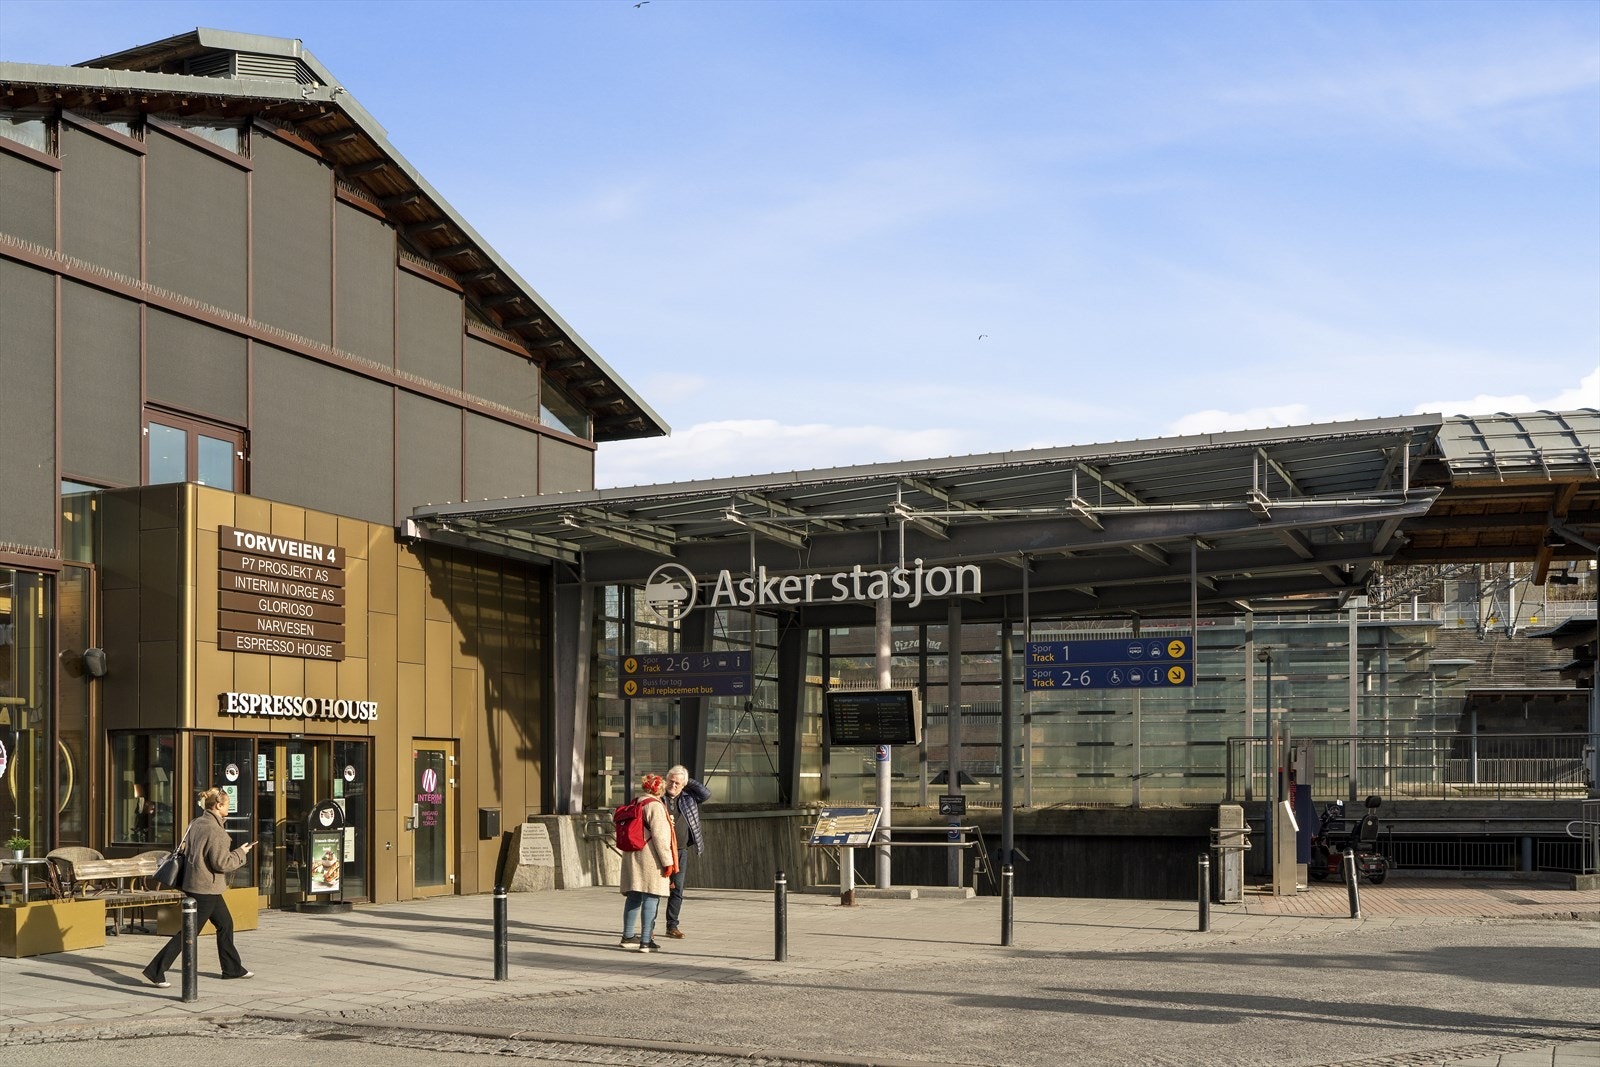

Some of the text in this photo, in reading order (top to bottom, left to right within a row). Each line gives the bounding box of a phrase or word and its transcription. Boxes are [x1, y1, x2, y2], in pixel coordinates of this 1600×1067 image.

[234, 531, 336, 563] TORVVEIEN 4
[242, 557, 329, 582] P7 PROSJEKT AS
[235, 576, 335, 601] INTERIM NORGE AS
[711, 558, 981, 608] Asker stasjon
[258, 599, 314, 617] GLORIOSO
[257, 618, 314, 636] NARVESEN
[236, 636, 333, 657] ESPRESSO HOUSE
[1032, 644, 1052, 654] Spor
[1062, 645, 1069, 661] 1
[666, 657, 690, 672] 2-6
[1032, 653, 1055, 662] Track
[1032, 669, 1052, 679] Spor
[1061, 670, 1091, 686] 2-6
[643, 685, 713, 695] Rail replacement bus
[660, 678, 669, 686] for
[670, 679, 682, 687] tog
[1032, 679, 1055, 687] Track
[226, 692, 378, 721] ESPRESSO HOUSE
[417, 794, 442, 802] INTERIM
